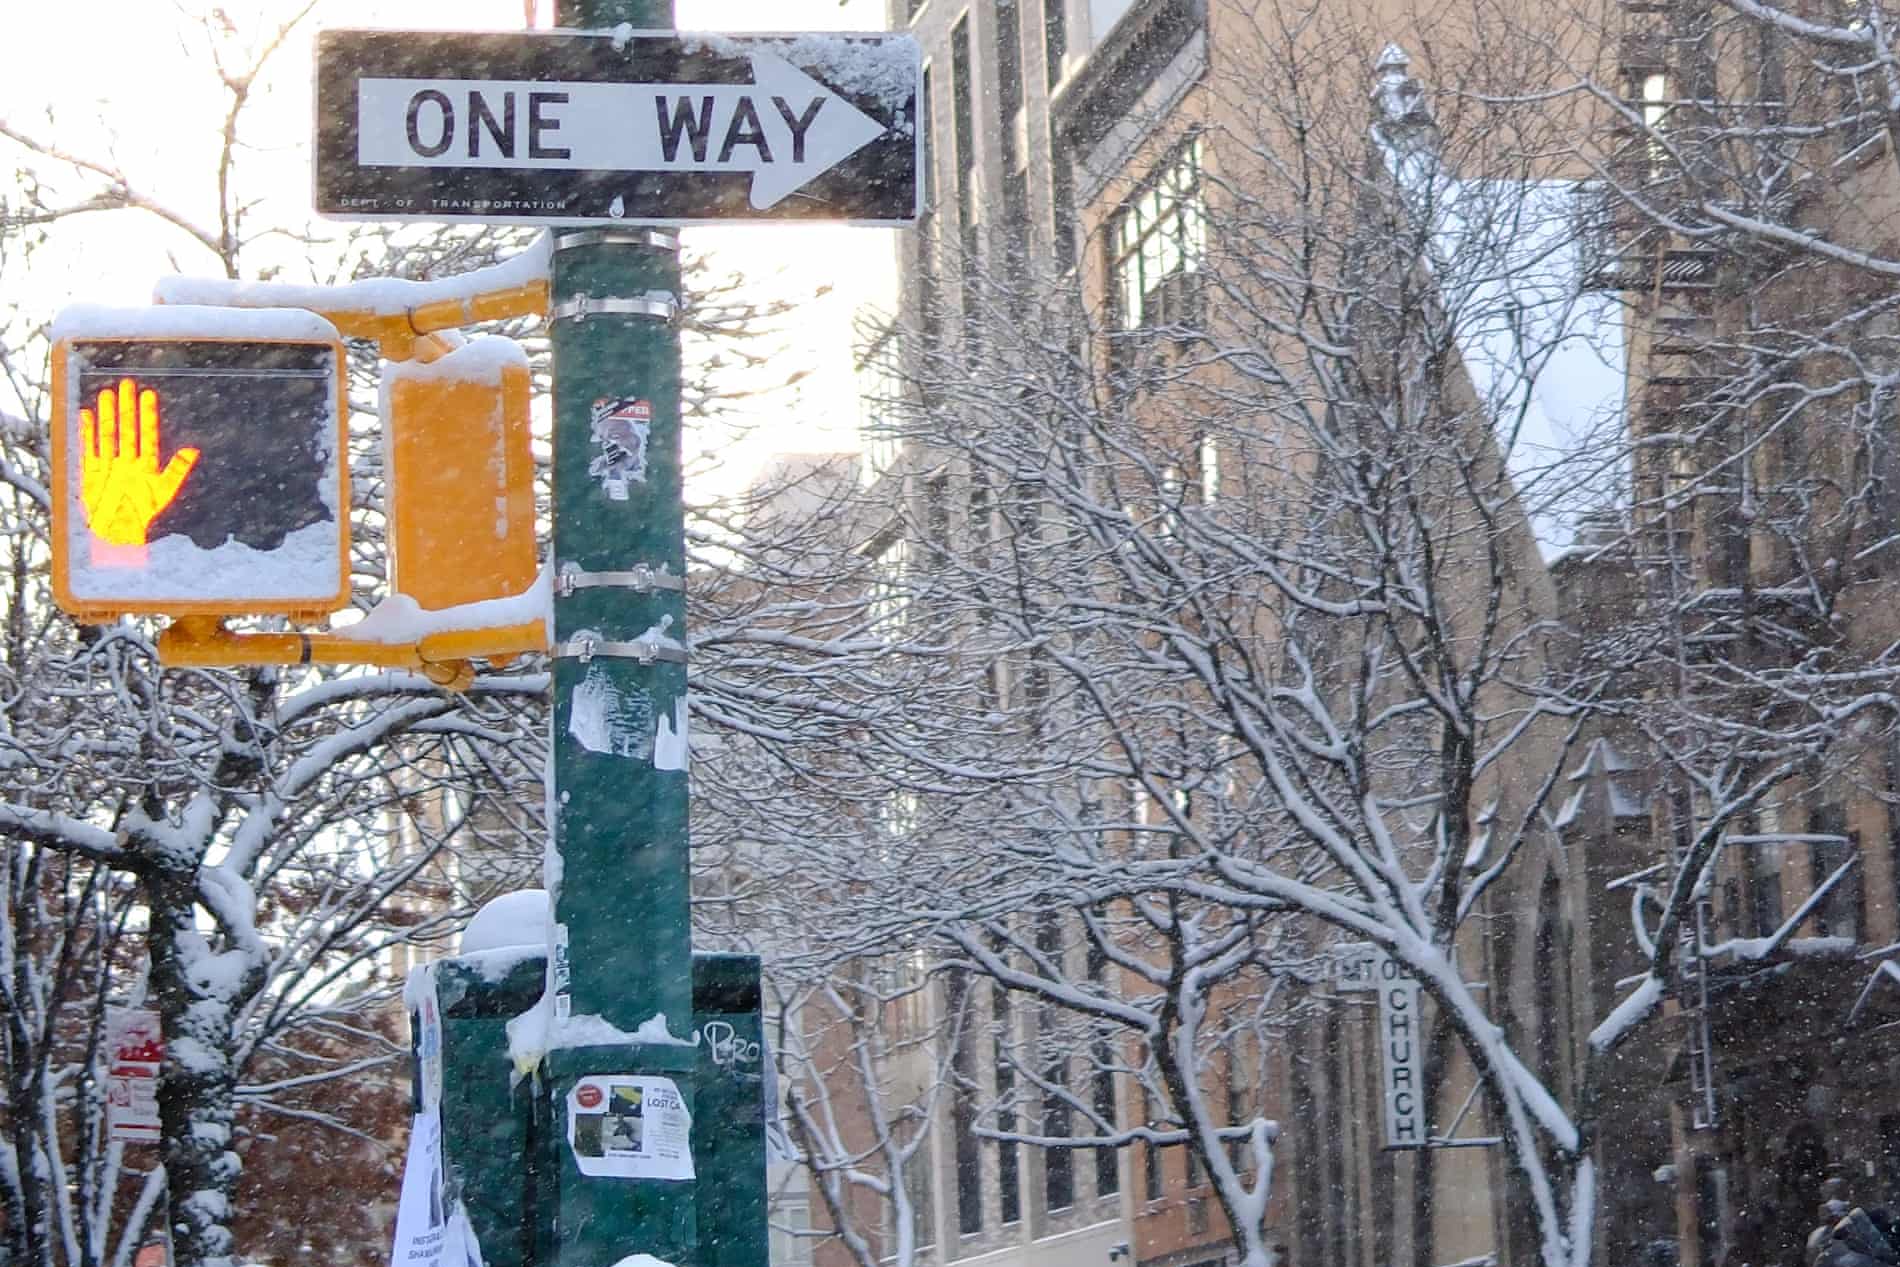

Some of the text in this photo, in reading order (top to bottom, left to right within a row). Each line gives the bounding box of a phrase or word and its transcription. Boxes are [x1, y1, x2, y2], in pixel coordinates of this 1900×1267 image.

[405, 88, 828, 164] ONE WAY
[395, 198, 416, 209] OF
[431, 199, 567, 210] TRANSPORTATION
[1388, 988, 1417, 1140] CHURCH
